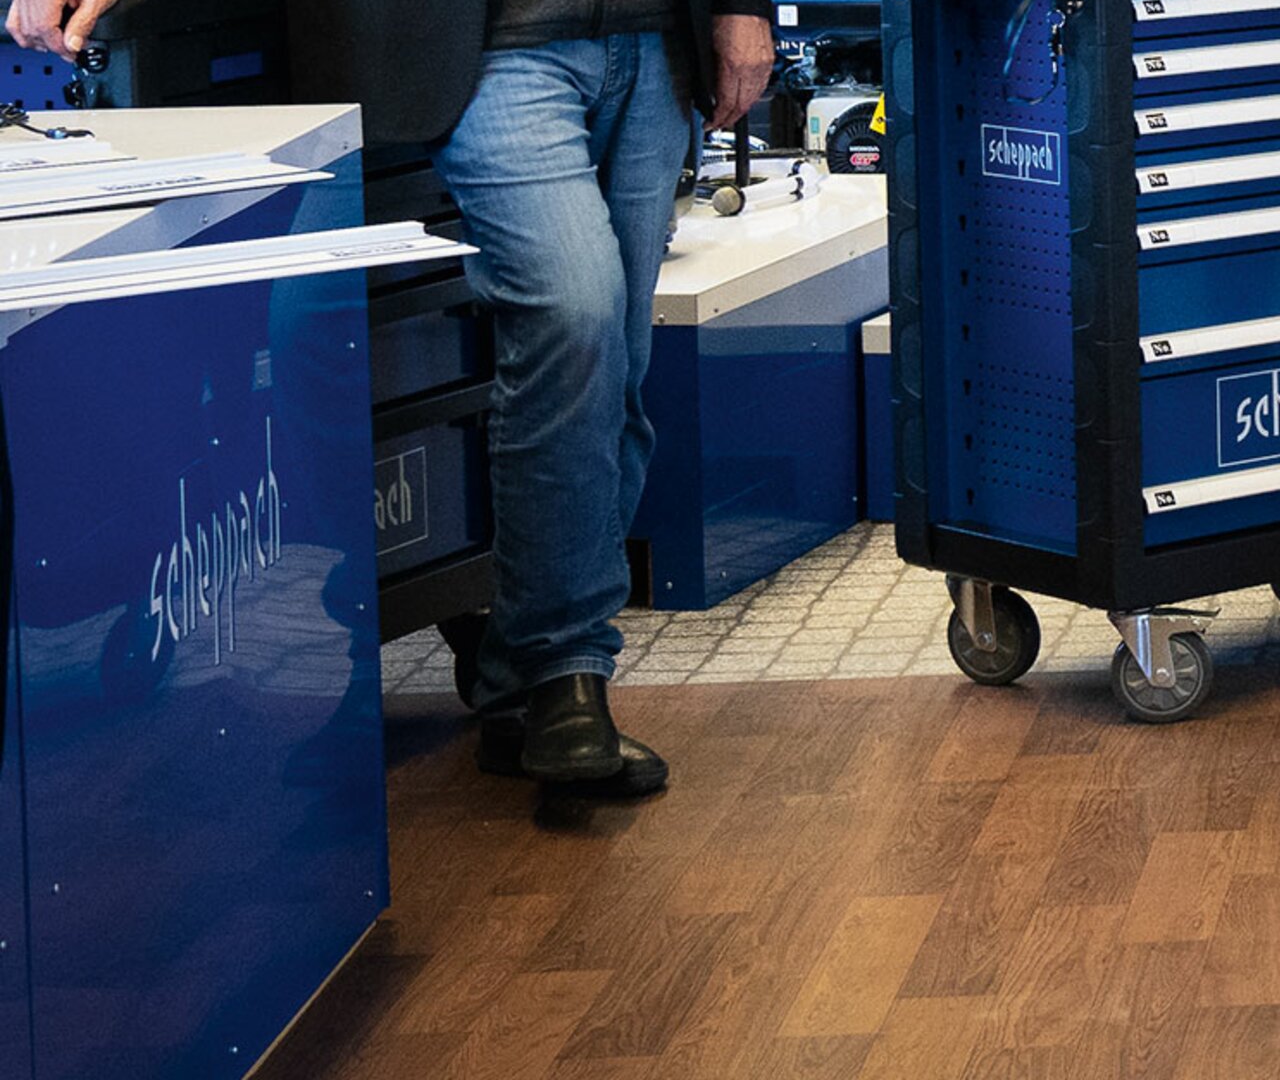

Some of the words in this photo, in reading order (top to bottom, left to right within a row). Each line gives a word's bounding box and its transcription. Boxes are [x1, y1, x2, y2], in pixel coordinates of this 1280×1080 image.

[989, 128, 1053, 178] scheppach
[374, 455, 412, 530] ach
[149, 416, 282, 665] scheppach
